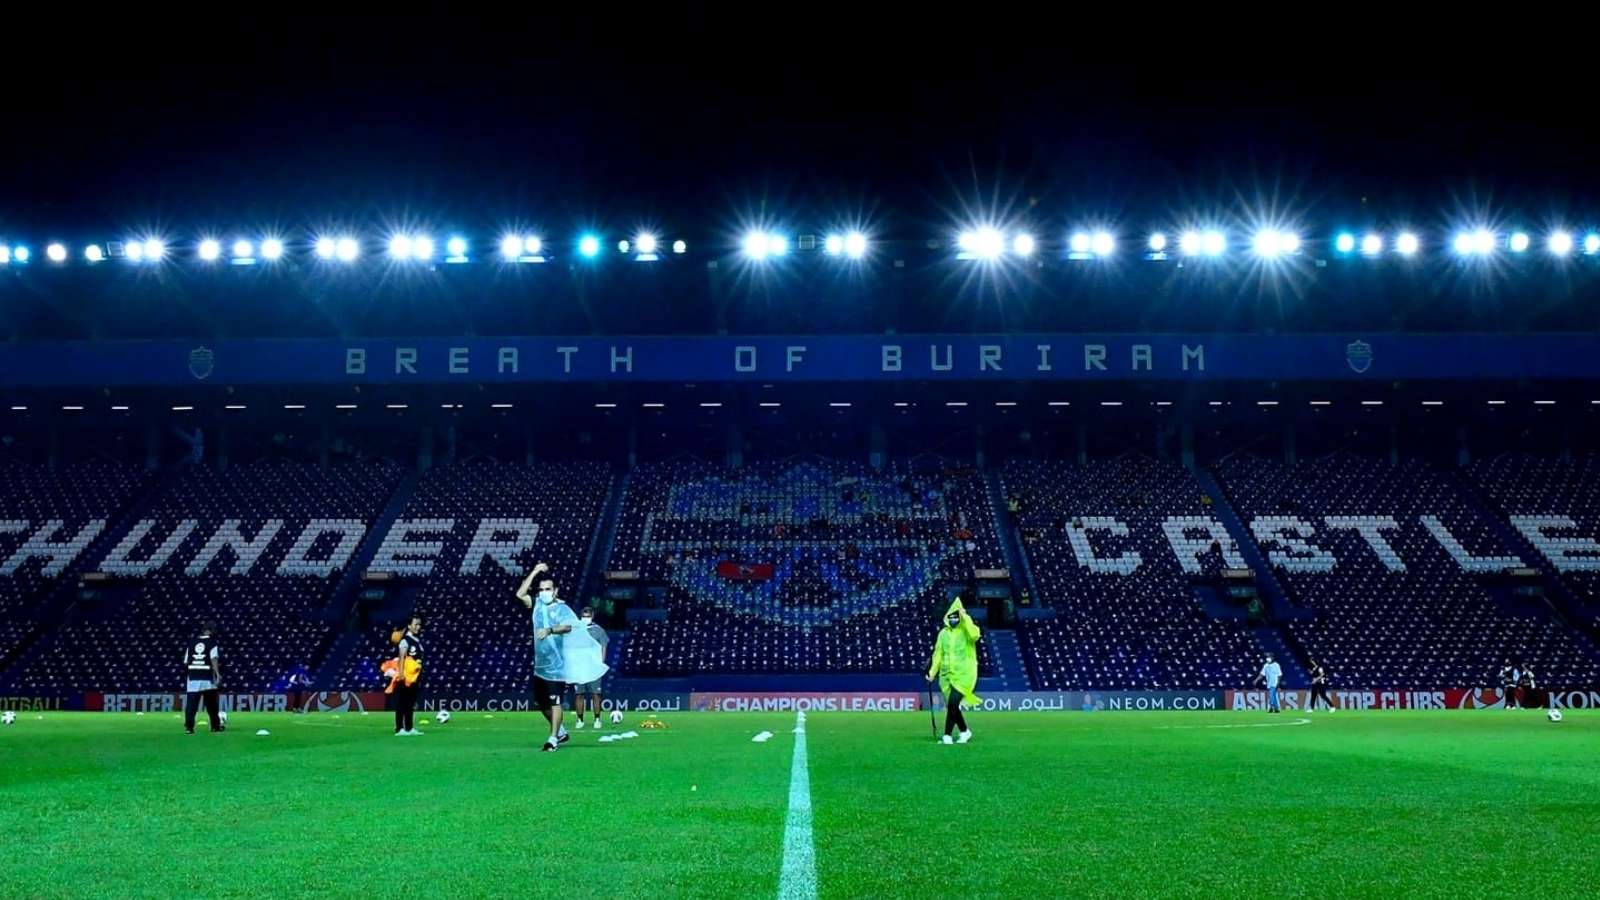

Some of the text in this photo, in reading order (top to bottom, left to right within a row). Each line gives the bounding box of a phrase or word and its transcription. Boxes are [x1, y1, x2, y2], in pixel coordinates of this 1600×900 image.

[346, 344, 1205, 374] BREATH OF BURIRAM
[104, 694, 174, 712] BETTER
[424, 699, 529, 711] NEOM.COM
[722, 697, 915, 711] CHAMPIONS LEAGUE
[1110, 697, 1216, 710] NEOM.COM
[1233, 691, 1299, 710] ASI'S
[1336, 691, 1376, 709] TOP
[1381, 691, 1446, 709] CLUBS
